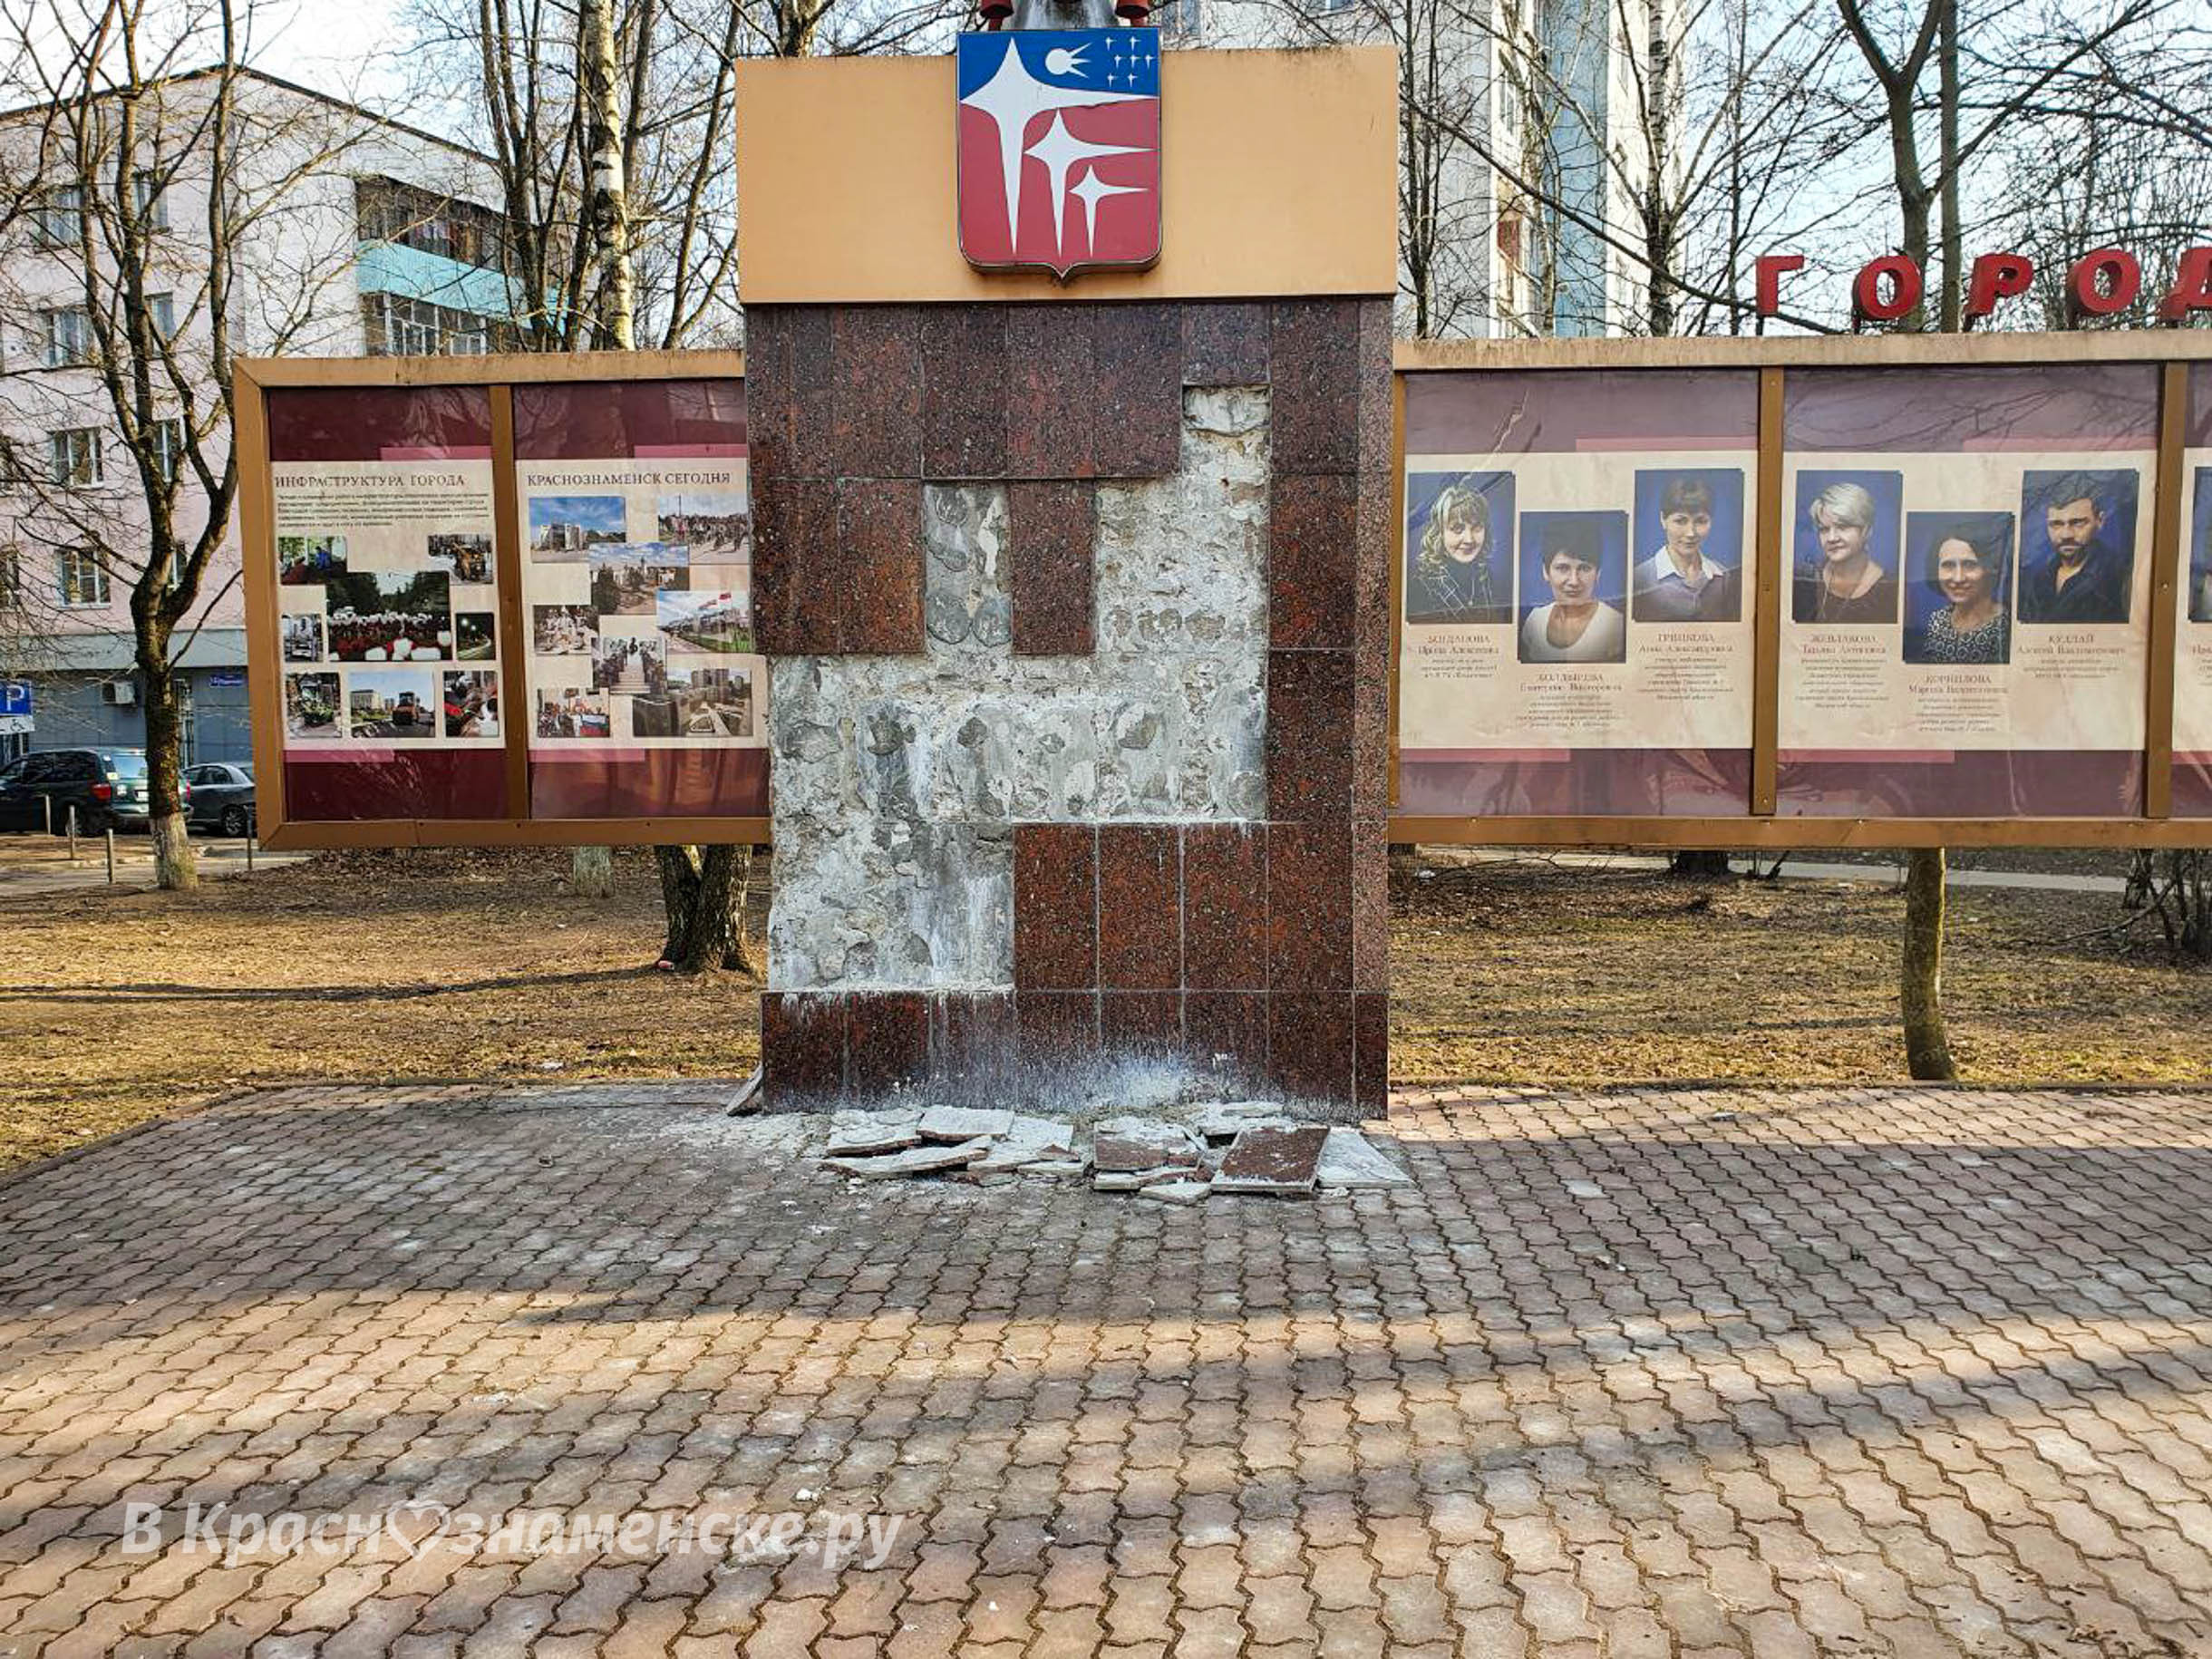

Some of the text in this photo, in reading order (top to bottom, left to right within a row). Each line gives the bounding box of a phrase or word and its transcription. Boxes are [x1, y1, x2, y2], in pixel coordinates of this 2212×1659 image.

[275, 474, 465, 488] ИНФРАСТРУКТУРА ГОРОДА
[528, 472, 732, 487] КРАСНОЗНАМЕНСК СЕГОДНЯ
